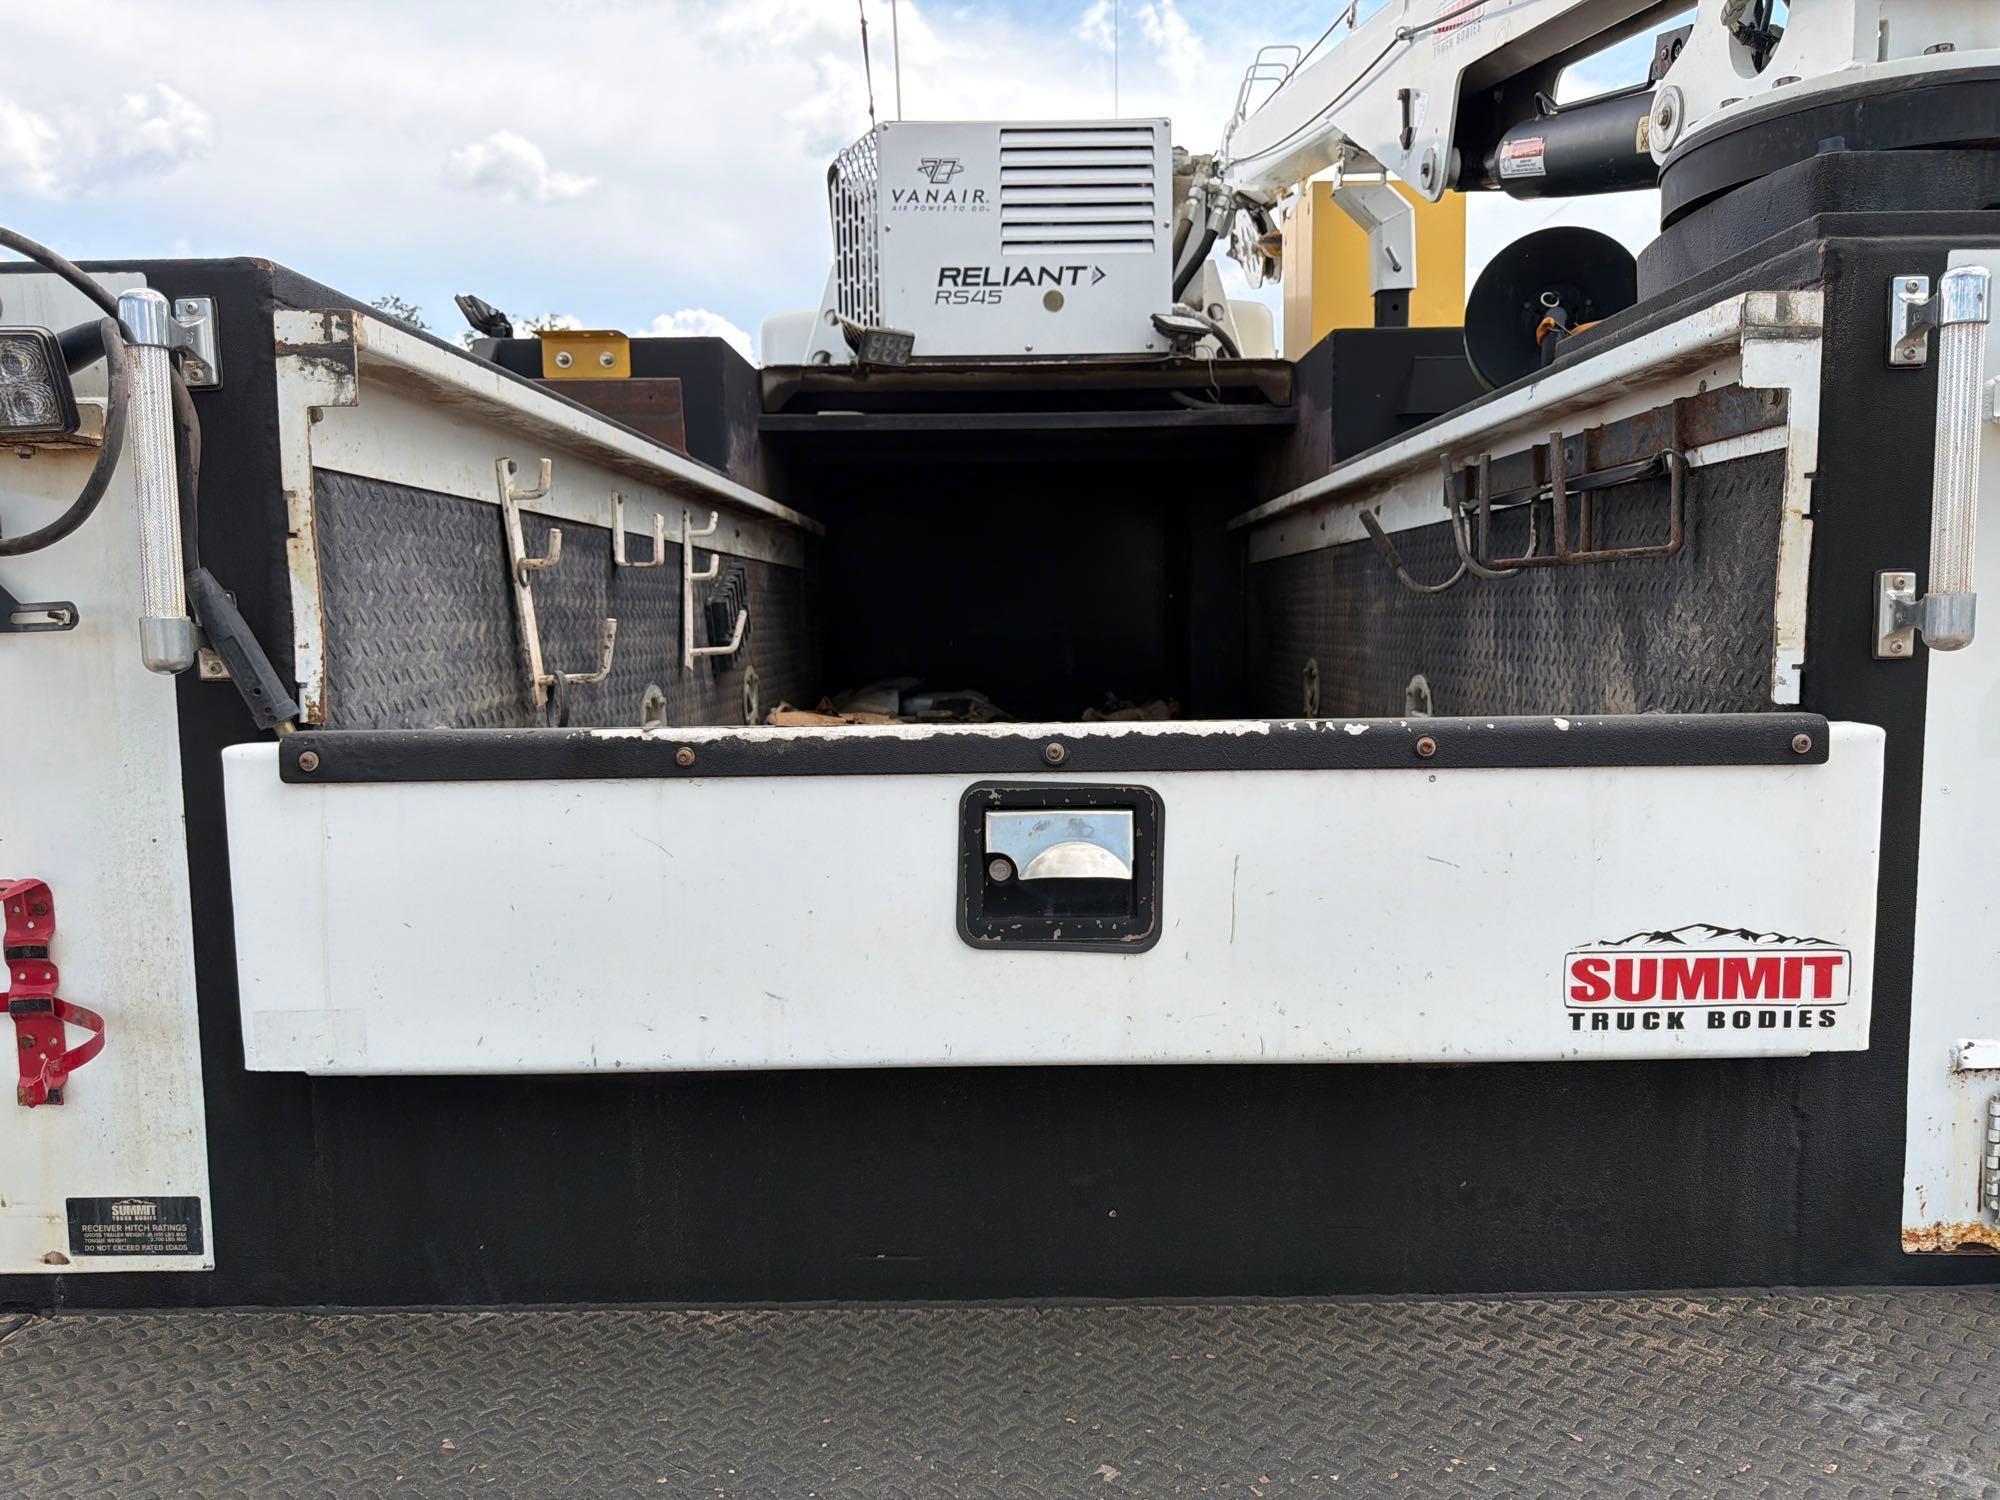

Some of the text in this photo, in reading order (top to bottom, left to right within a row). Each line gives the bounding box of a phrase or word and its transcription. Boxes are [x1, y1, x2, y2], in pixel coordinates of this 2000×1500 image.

[892, 189, 985, 204] VANAIR
[938, 266, 1088, 287] RELIANT
[934, 290, 1003, 305] RS45
[1570, 956, 1844, 1002] SUMMIT
[1568, 1009, 1837, 1031] TRUCK BODIES
[111, 1204, 157, 1216] SUMMIT
[82, 1224, 122, 1232] RECEIVER
[125, 1224, 150, 1232] HITCH
